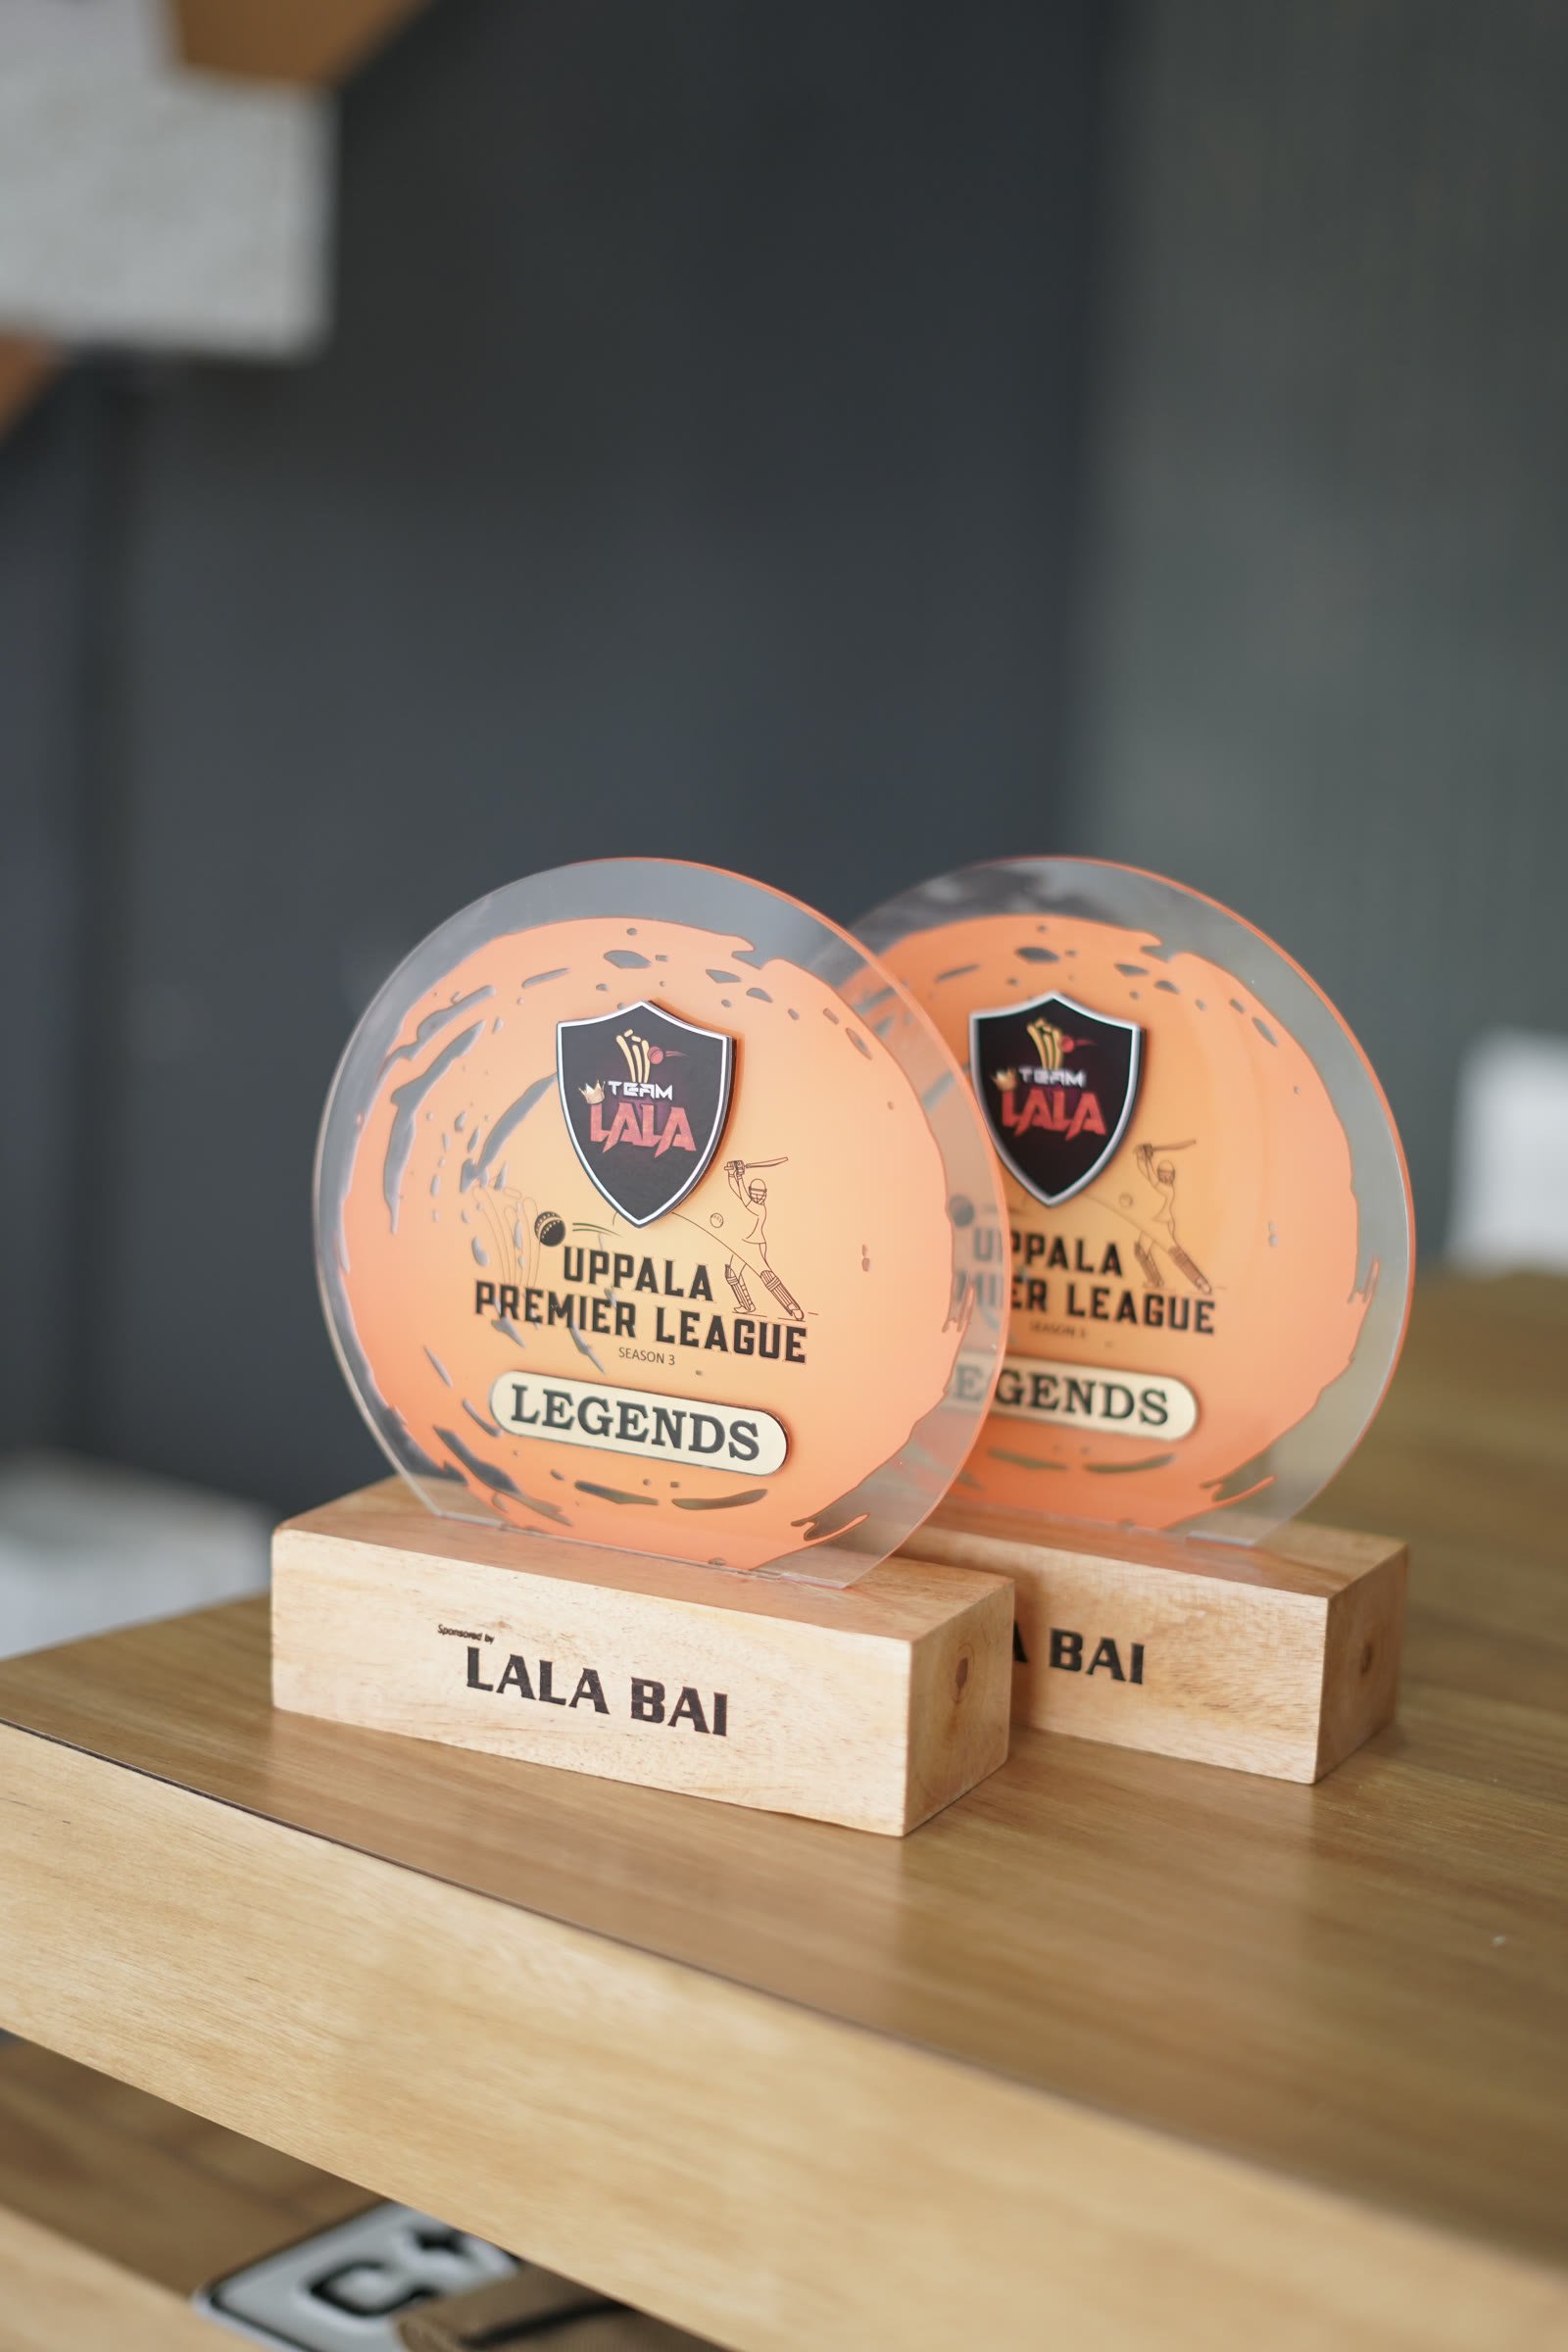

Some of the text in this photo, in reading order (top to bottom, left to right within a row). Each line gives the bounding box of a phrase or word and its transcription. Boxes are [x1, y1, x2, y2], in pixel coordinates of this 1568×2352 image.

[608, 1081, 672, 1101] TEAM
[1018, 1068, 1086, 1087] TEAM
[590, 1102, 697, 1158] LALA
[1002, 1088, 1106, 1142] LALA
[564, 1247, 713, 1301] UPPALA
[475, 1281, 808, 1364] PREMIER LEAGUE
[1066, 1282, 1216, 1336] LEAGUE
[618, 1347, 676, 1366] SEASON 3
[956, 1363, 1170, 1427] EGENDS
[511, 1384, 761, 1461] LEGENDS
[437, 1623, 495, 1644] Sponsored by
[1050, 1627, 1145, 1686] BAI
[466, 1645, 728, 1737] LALA BAI
